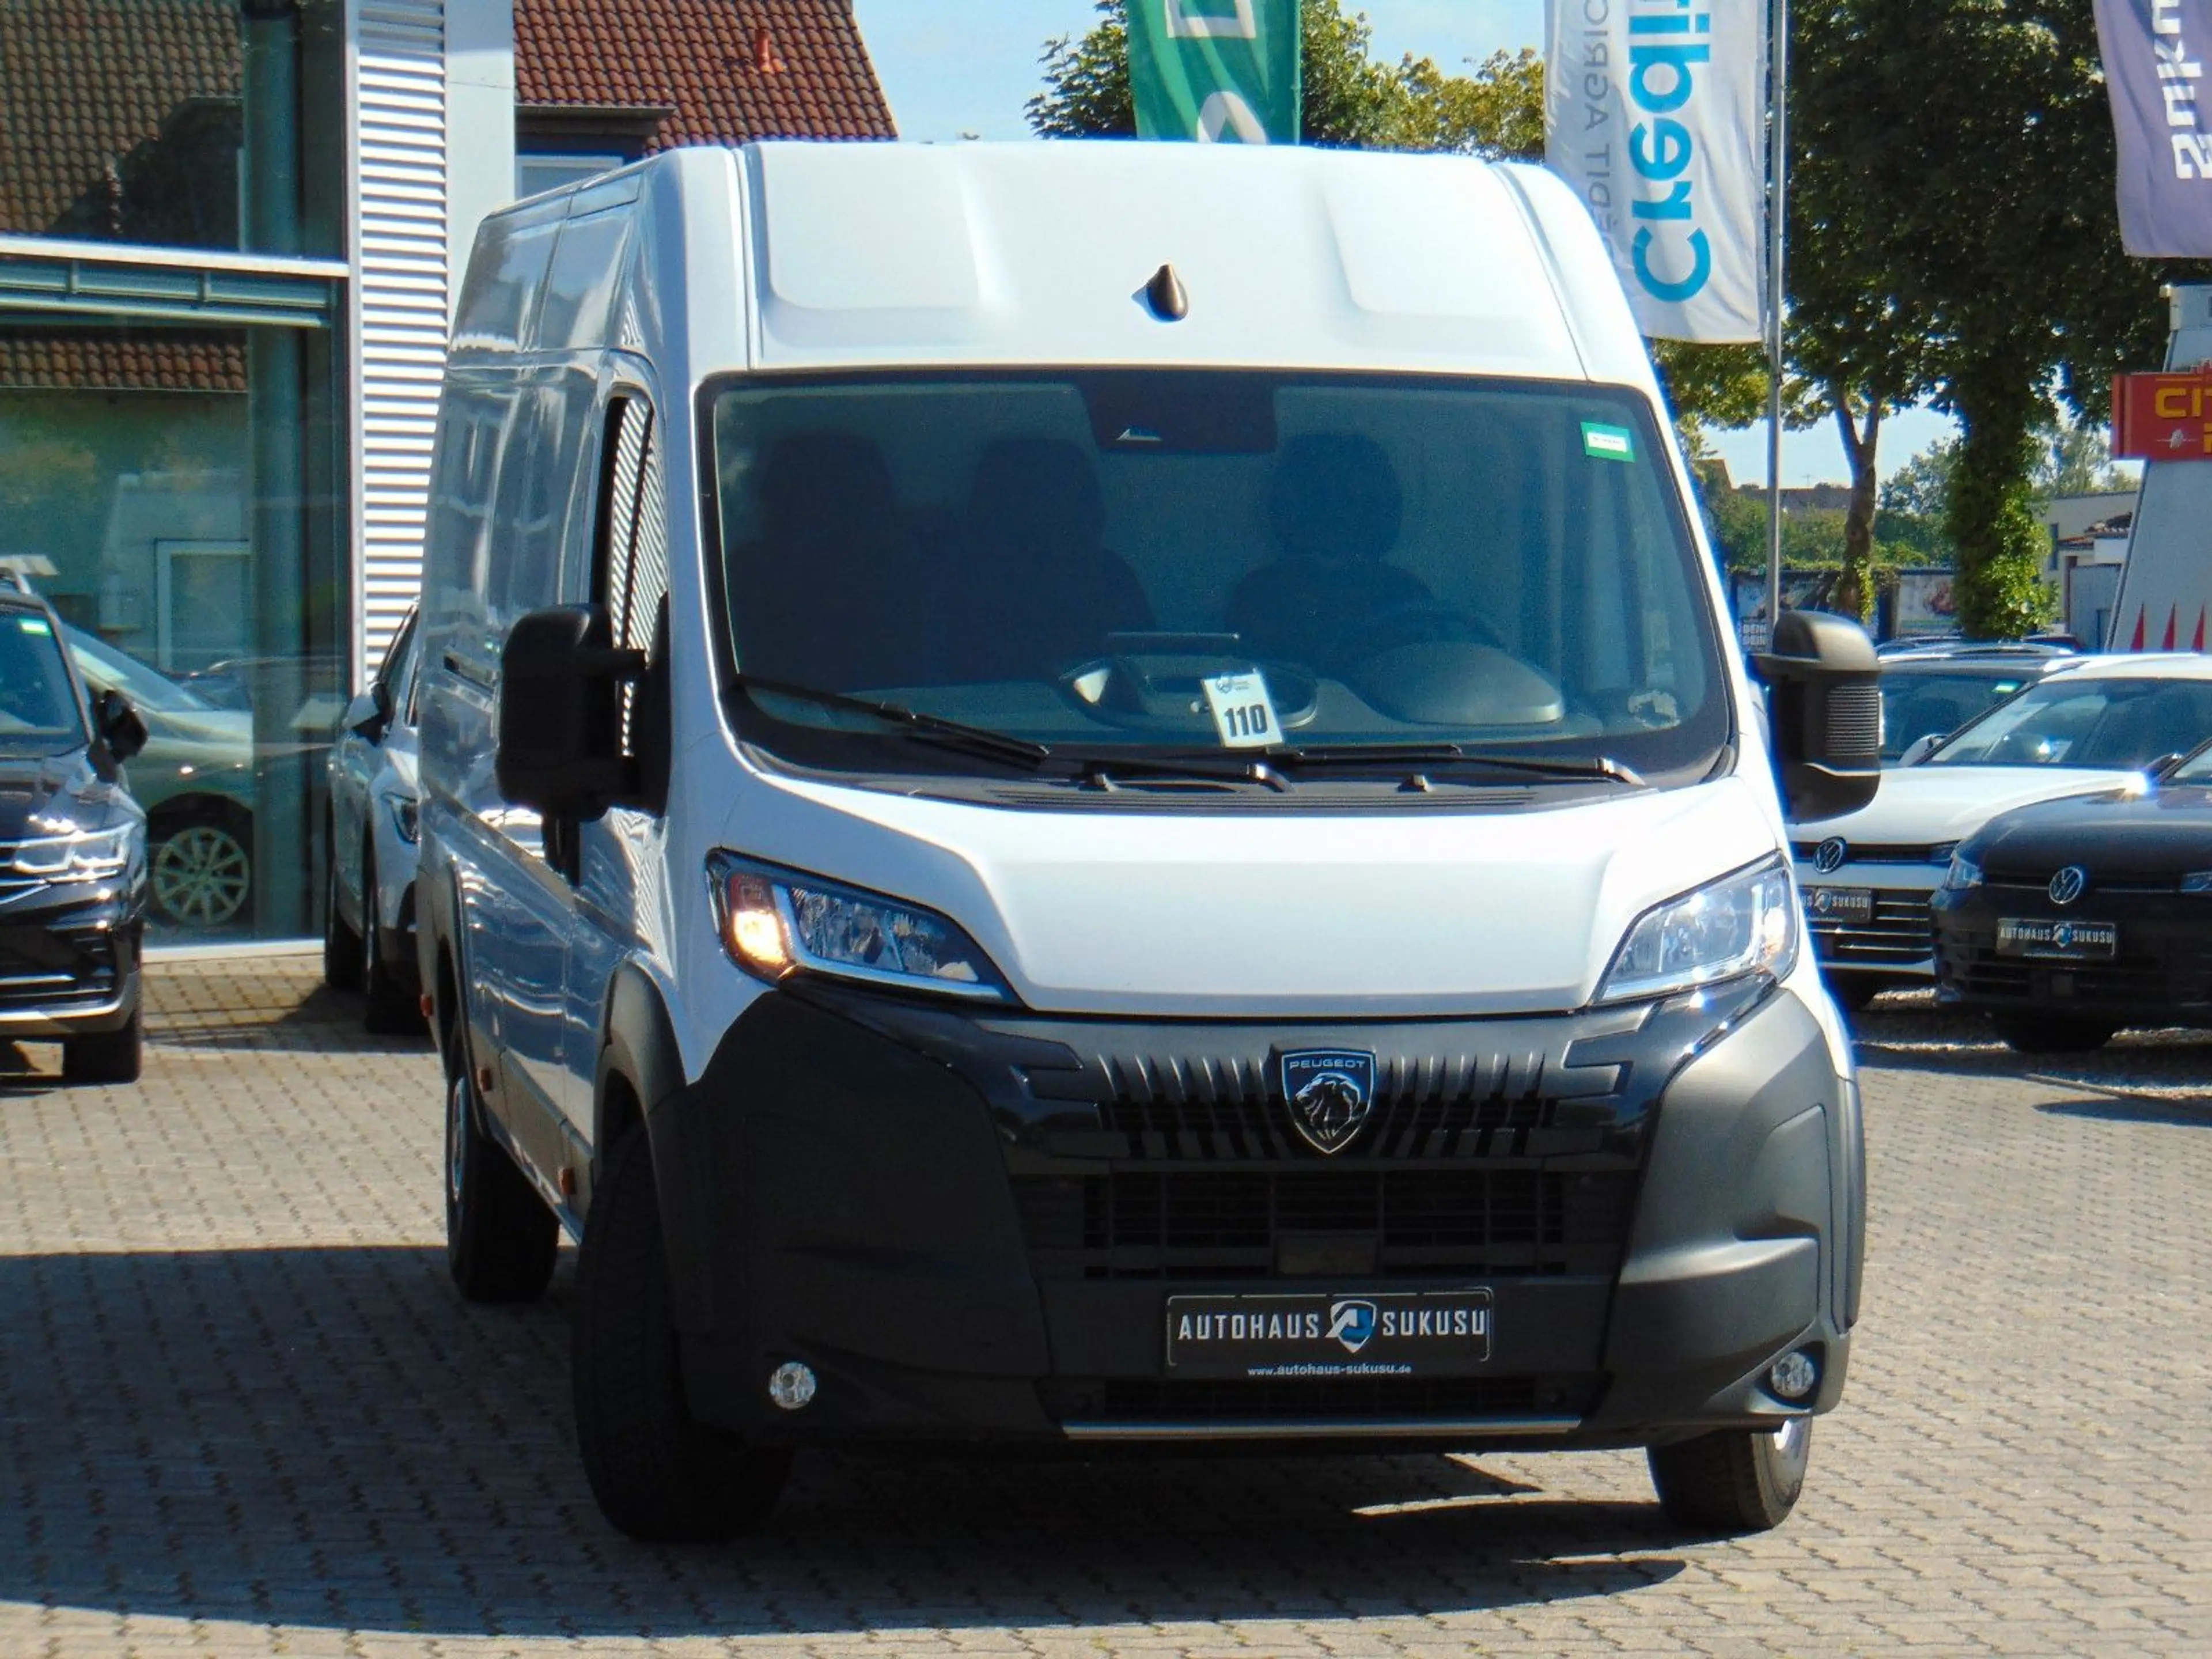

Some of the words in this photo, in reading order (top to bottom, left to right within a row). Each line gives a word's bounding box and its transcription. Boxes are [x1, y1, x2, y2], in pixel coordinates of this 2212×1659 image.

[1224, 704, 1268, 737] 110
[1832, 896, 1868, 908] SUKUSU
[2000, 927, 2051, 941] AUTOHAUS
[2072, 930, 2112, 944] SUKUSU
[1289, 1058, 1366, 1070] PEUGEOT
[1177, 1314, 1320, 1340] AUTOHAUS
[1382, 1309, 1486, 1336] SUKUSU
[1247, 1363, 1412, 1376] www.autohaus-sukusu.de
